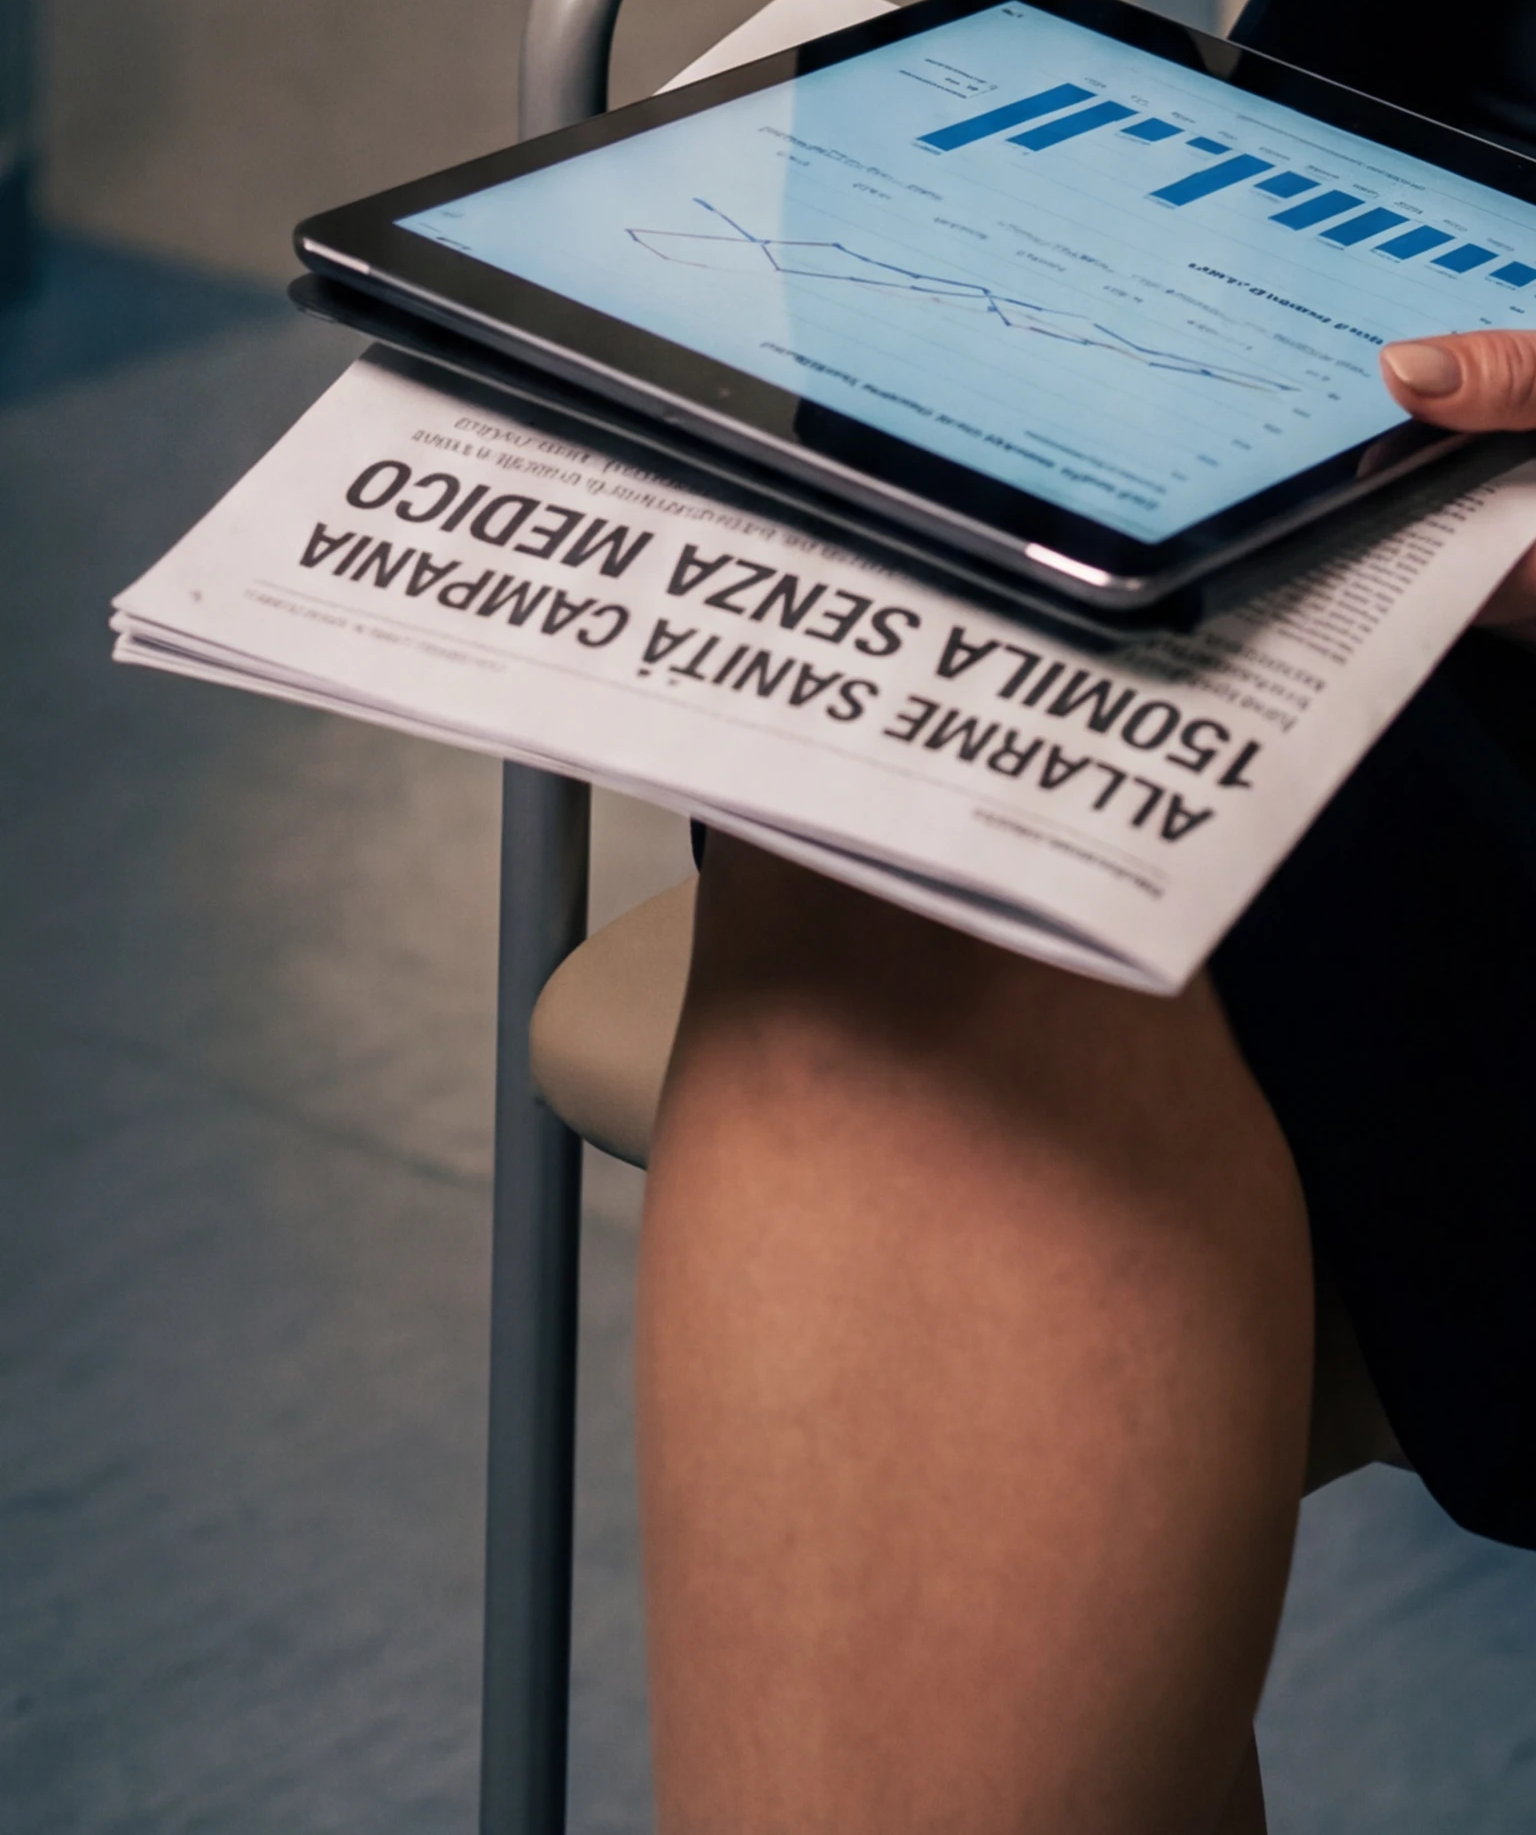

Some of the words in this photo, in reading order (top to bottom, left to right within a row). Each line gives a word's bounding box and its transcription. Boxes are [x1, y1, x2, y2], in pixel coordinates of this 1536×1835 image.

[345, 459, 655, 579] MEDICO
[299, 522, 630, 648] CAMPANIA
[666, 543, 921, 657] SENZA
[883, 695, 1214, 843] ALLARME
[935, 625, 1262, 789] 150MILA
